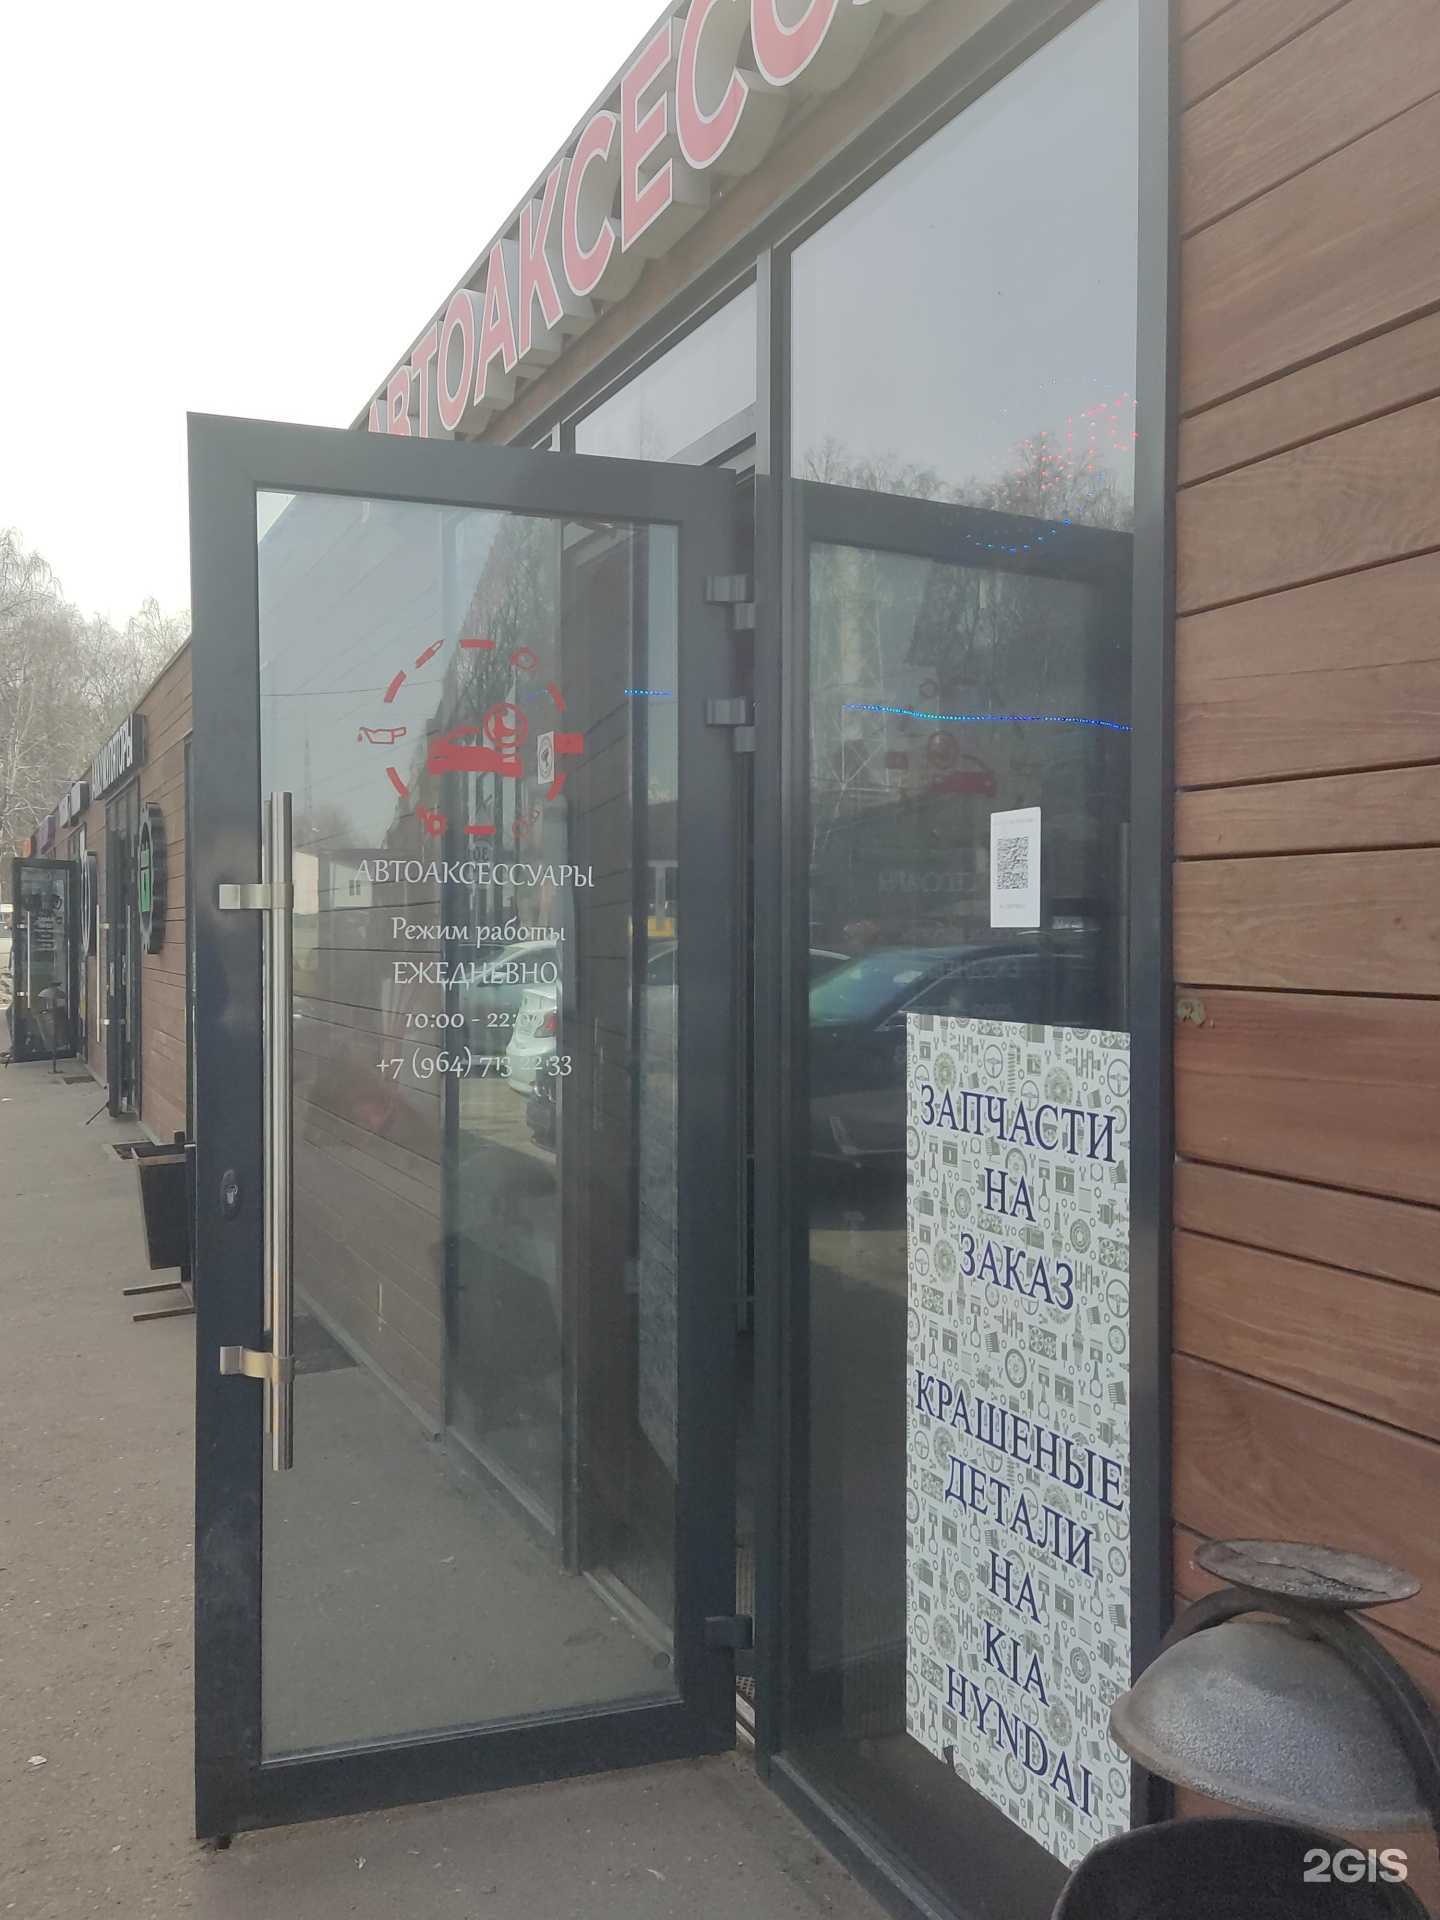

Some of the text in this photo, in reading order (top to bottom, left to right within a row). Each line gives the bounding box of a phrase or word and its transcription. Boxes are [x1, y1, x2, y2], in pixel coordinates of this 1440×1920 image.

[355, 860, 595, 888] АВТОАКСЕССУАРЫ
[392, 916, 566, 948] Режим работы
[392, 961, 558, 991] ЕЖЕДНЕВНО
[405, 1013, 465, 1029] 10:00
[376, 1058, 404, 1080] +7
[412, 1046, 473, 1079] (964)
[920, 1083, 1118, 1163] ЗАПЧАСТИ
[983, 1167, 1037, 1223] НА
[959, 1231, 1075, 1311] ЗАКАЗ
[914, 1368, 1126, 1512] КРАШЕНЫЕ
[944, 1454, 1096, 1578] ДЕТАЛИ
[988, 1549, 1043, 1625] НА
[983, 1619, 1051, 1708] KIA
[945, 1663, 1095, 1818] HYNDAI
